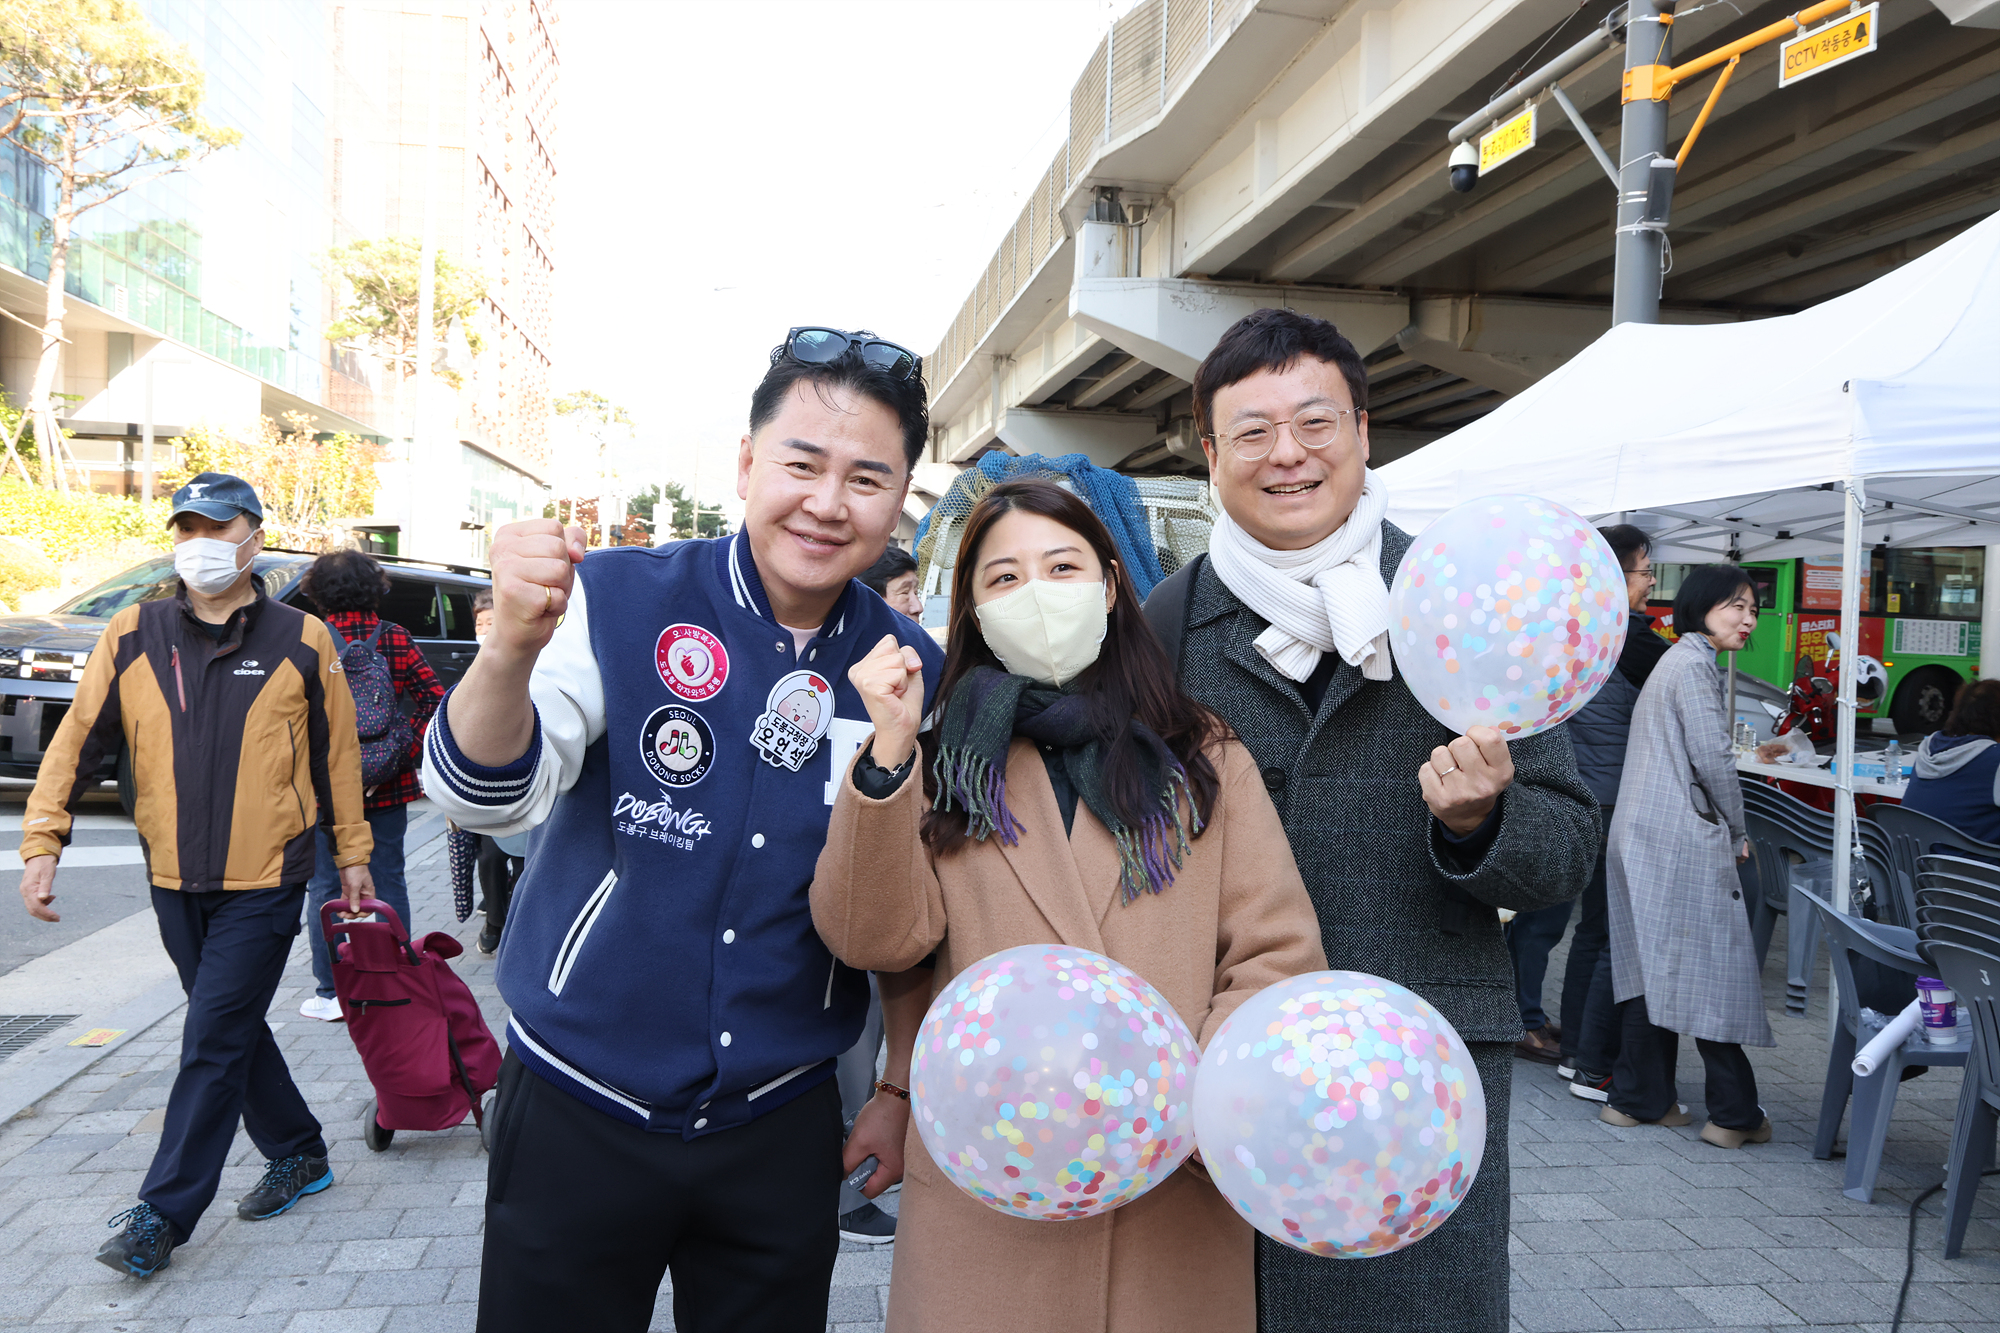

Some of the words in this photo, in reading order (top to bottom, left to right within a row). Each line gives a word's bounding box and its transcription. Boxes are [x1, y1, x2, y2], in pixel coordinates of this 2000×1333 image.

[1786, 43, 1819, 70] CCTV
[1821, 29, 1852, 54] 작동중
[659, 660, 677, 685] 도봉형
[676, 683, 707, 698] 약자와의
[706, 676, 721, 692] 동행
[668, 710, 697, 726] SEOUL
[771, 716, 809, 748] 도봉구청장
[645, 750, 678, 783] DOBONG
[680, 763, 705, 783] SOCKS
[612, 791, 706, 836] DOBONG
[617, 821, 648, 838] 도봉구
[648, 828, 695, 851] 브레이킹팀
